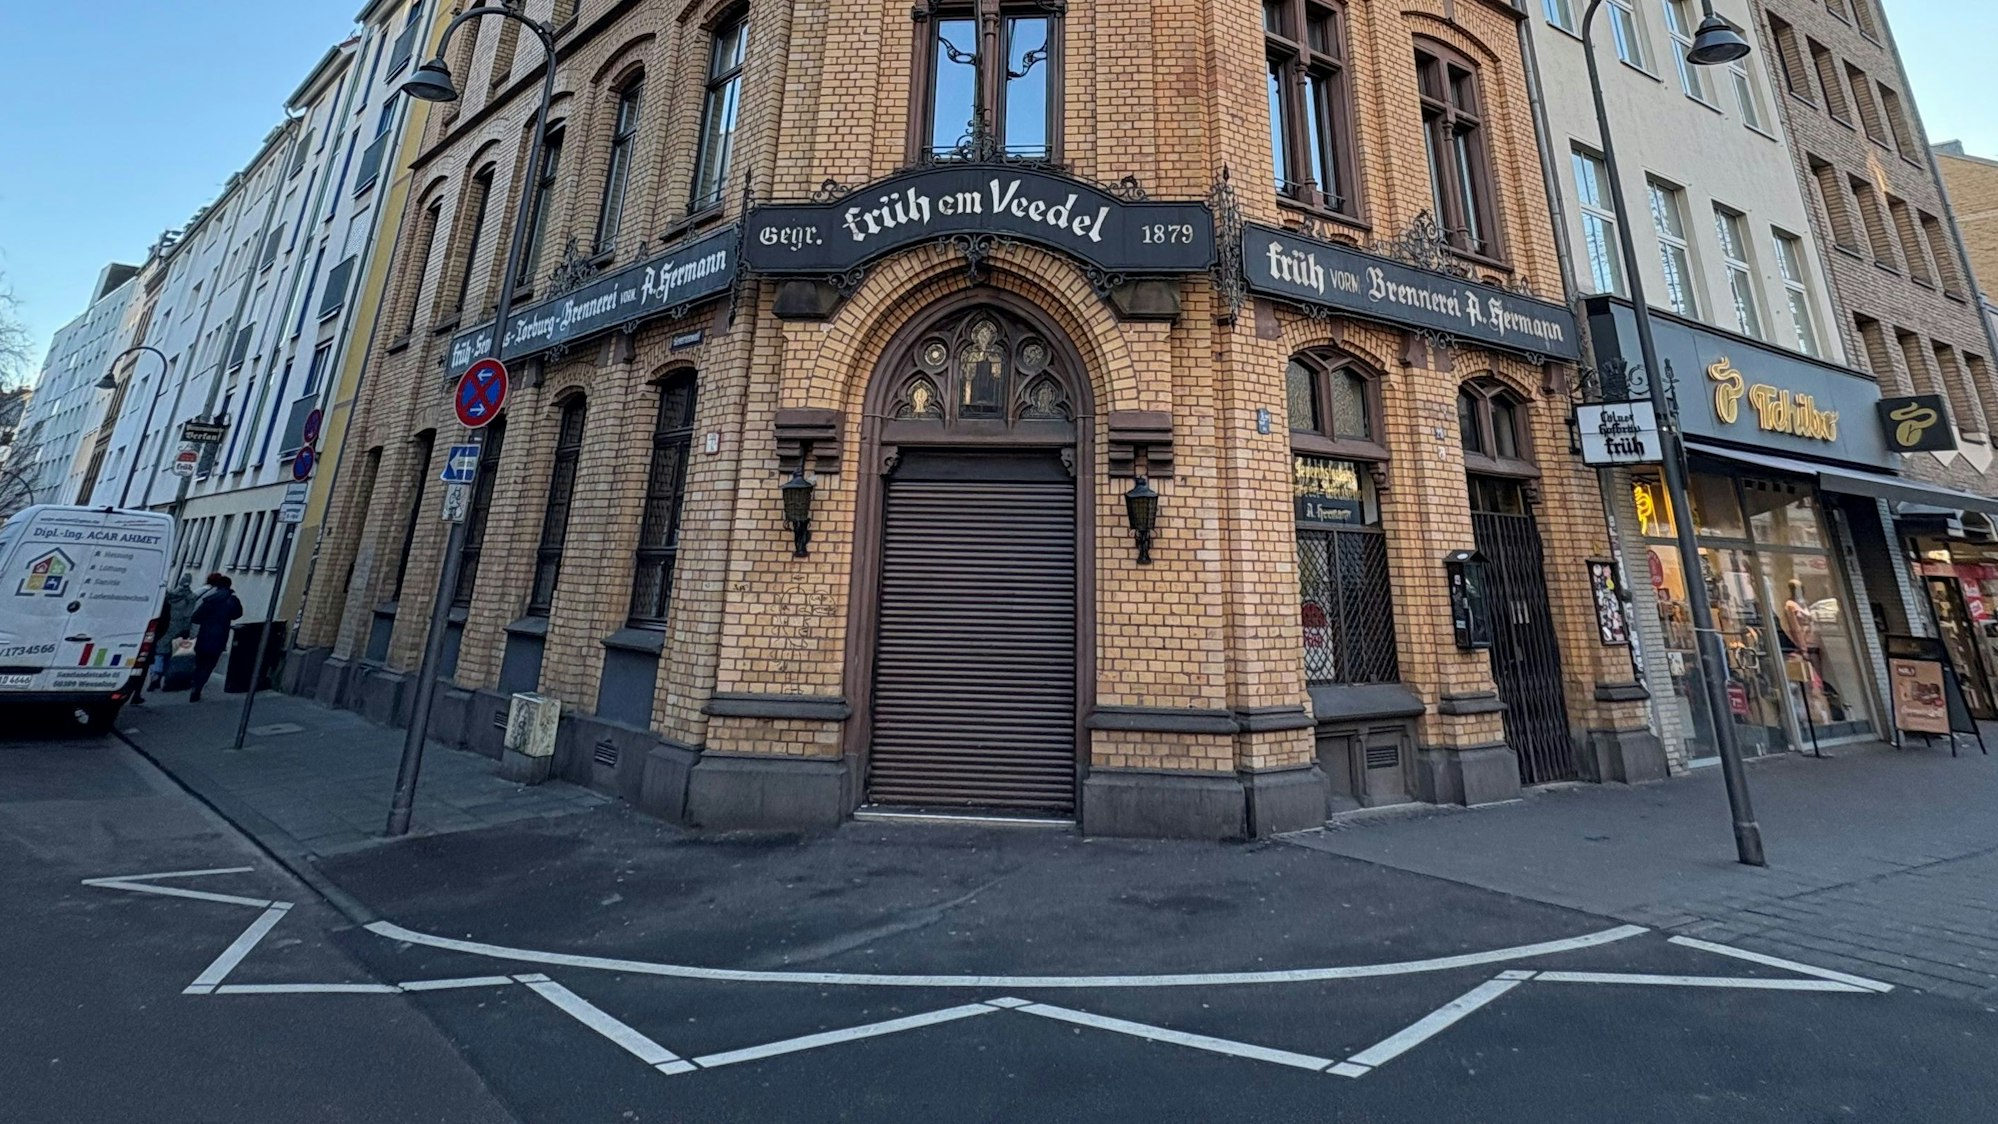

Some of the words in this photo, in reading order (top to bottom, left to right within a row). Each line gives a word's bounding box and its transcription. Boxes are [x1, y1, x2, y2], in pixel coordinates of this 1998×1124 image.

[759, 226, 823, 251] Gegr.
[938, 191, 983, 216] em
[989, 178, 1110, 243] Veedel
[1141, 224, 1194, 244] 1879
[1366, 266, 1462, 319] Brennerei
[1749, 383, 1838, 442] Tchibo
[33, 527, 84, 540] Dipl.-Ing.
[87, 531, 118, 541] ACAR
[121, 534, 161, 545] AHMET
